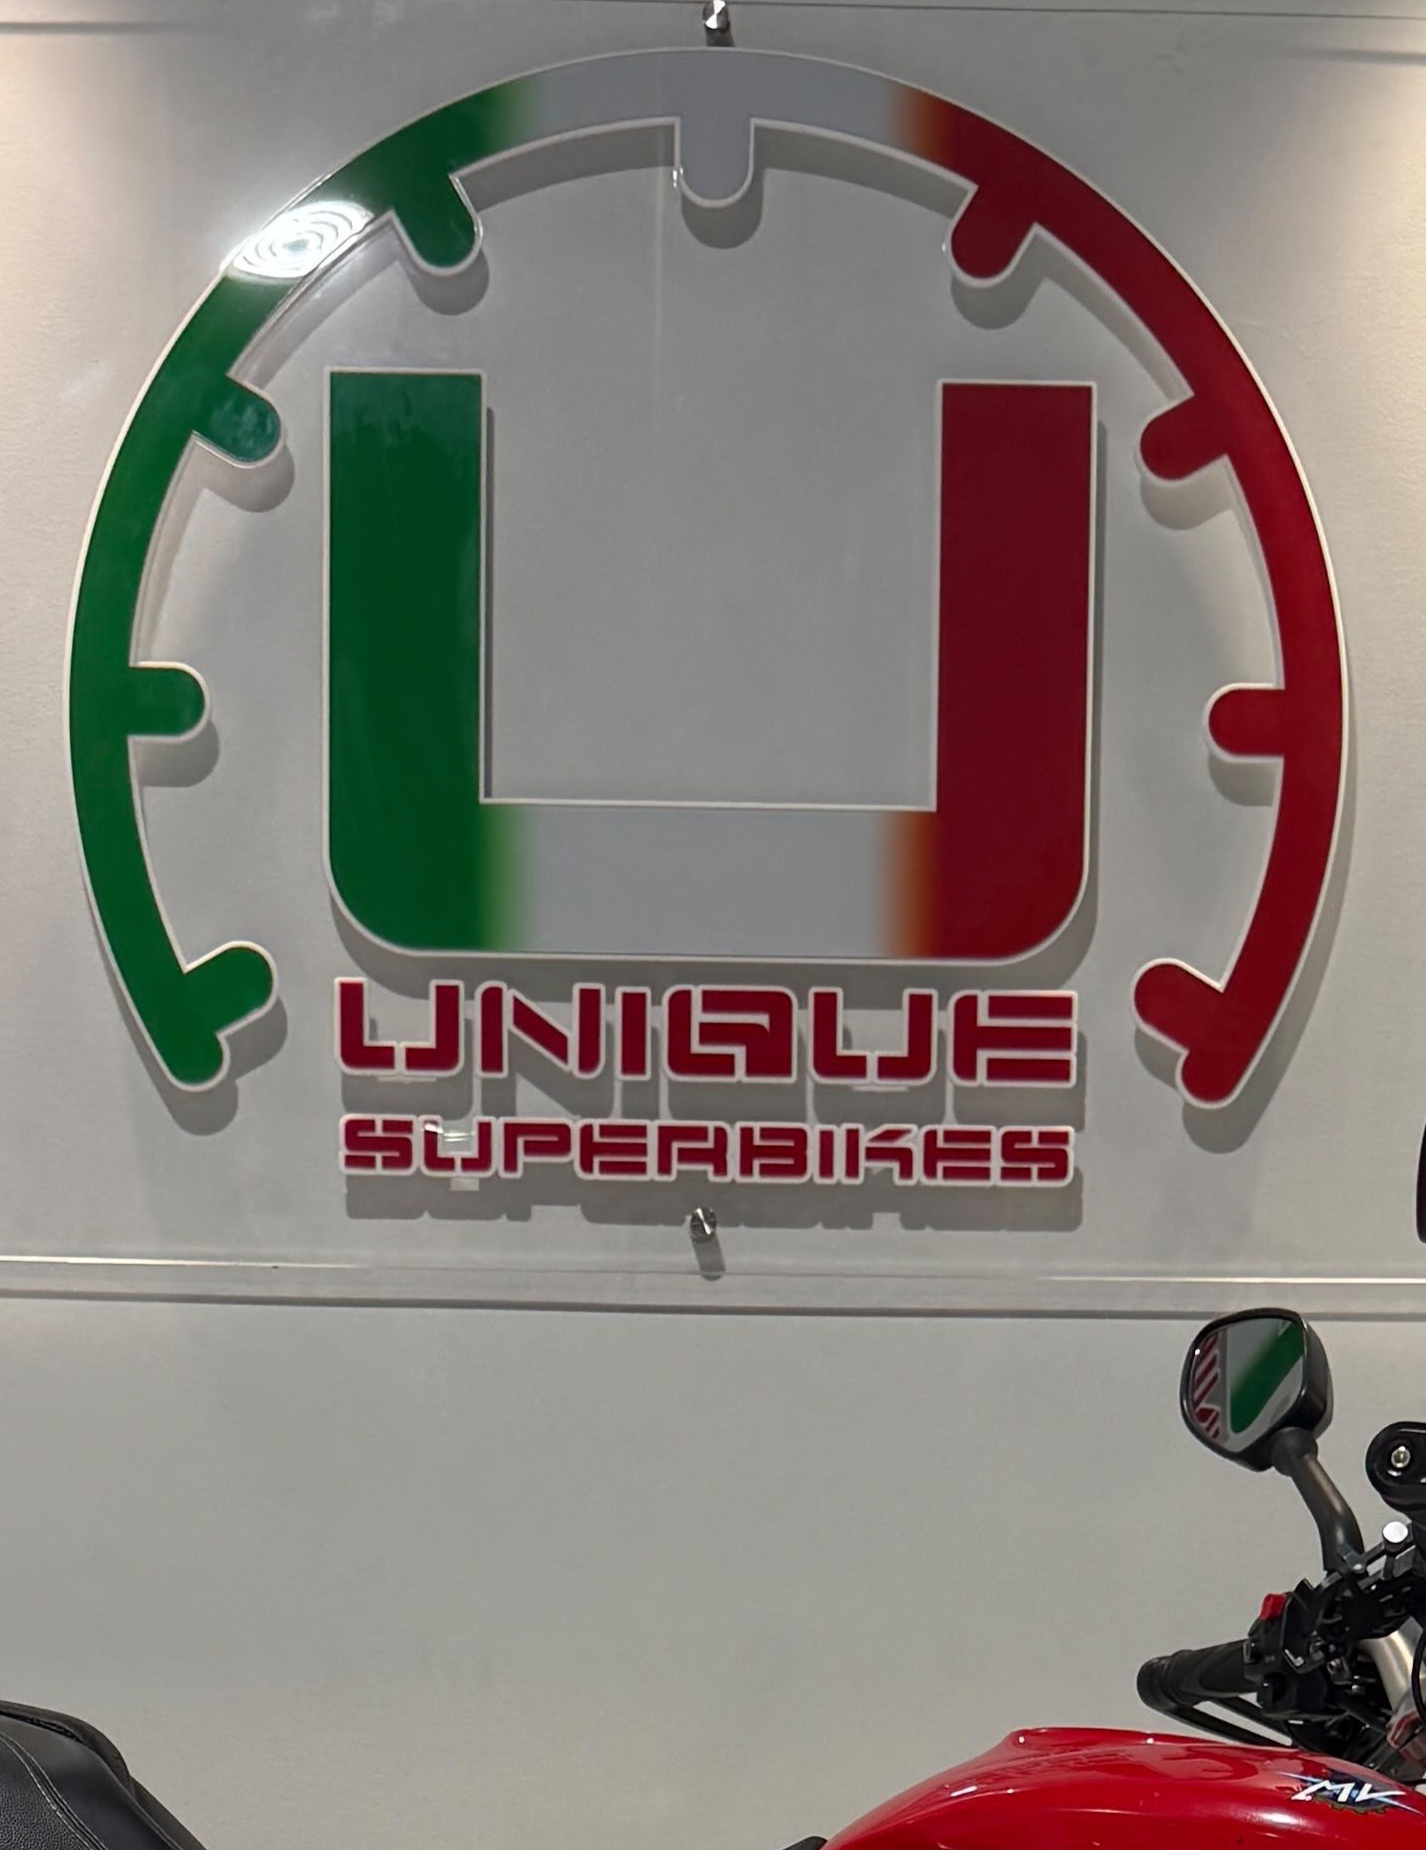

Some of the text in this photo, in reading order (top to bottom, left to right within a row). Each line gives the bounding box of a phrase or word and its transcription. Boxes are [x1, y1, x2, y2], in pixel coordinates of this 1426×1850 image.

[336, 977, 1078, 1087] UNIQUE
[339, 1114, 1075, 1186] SUPERBIKES
[1290, 1779, 1407, 1803] MV
